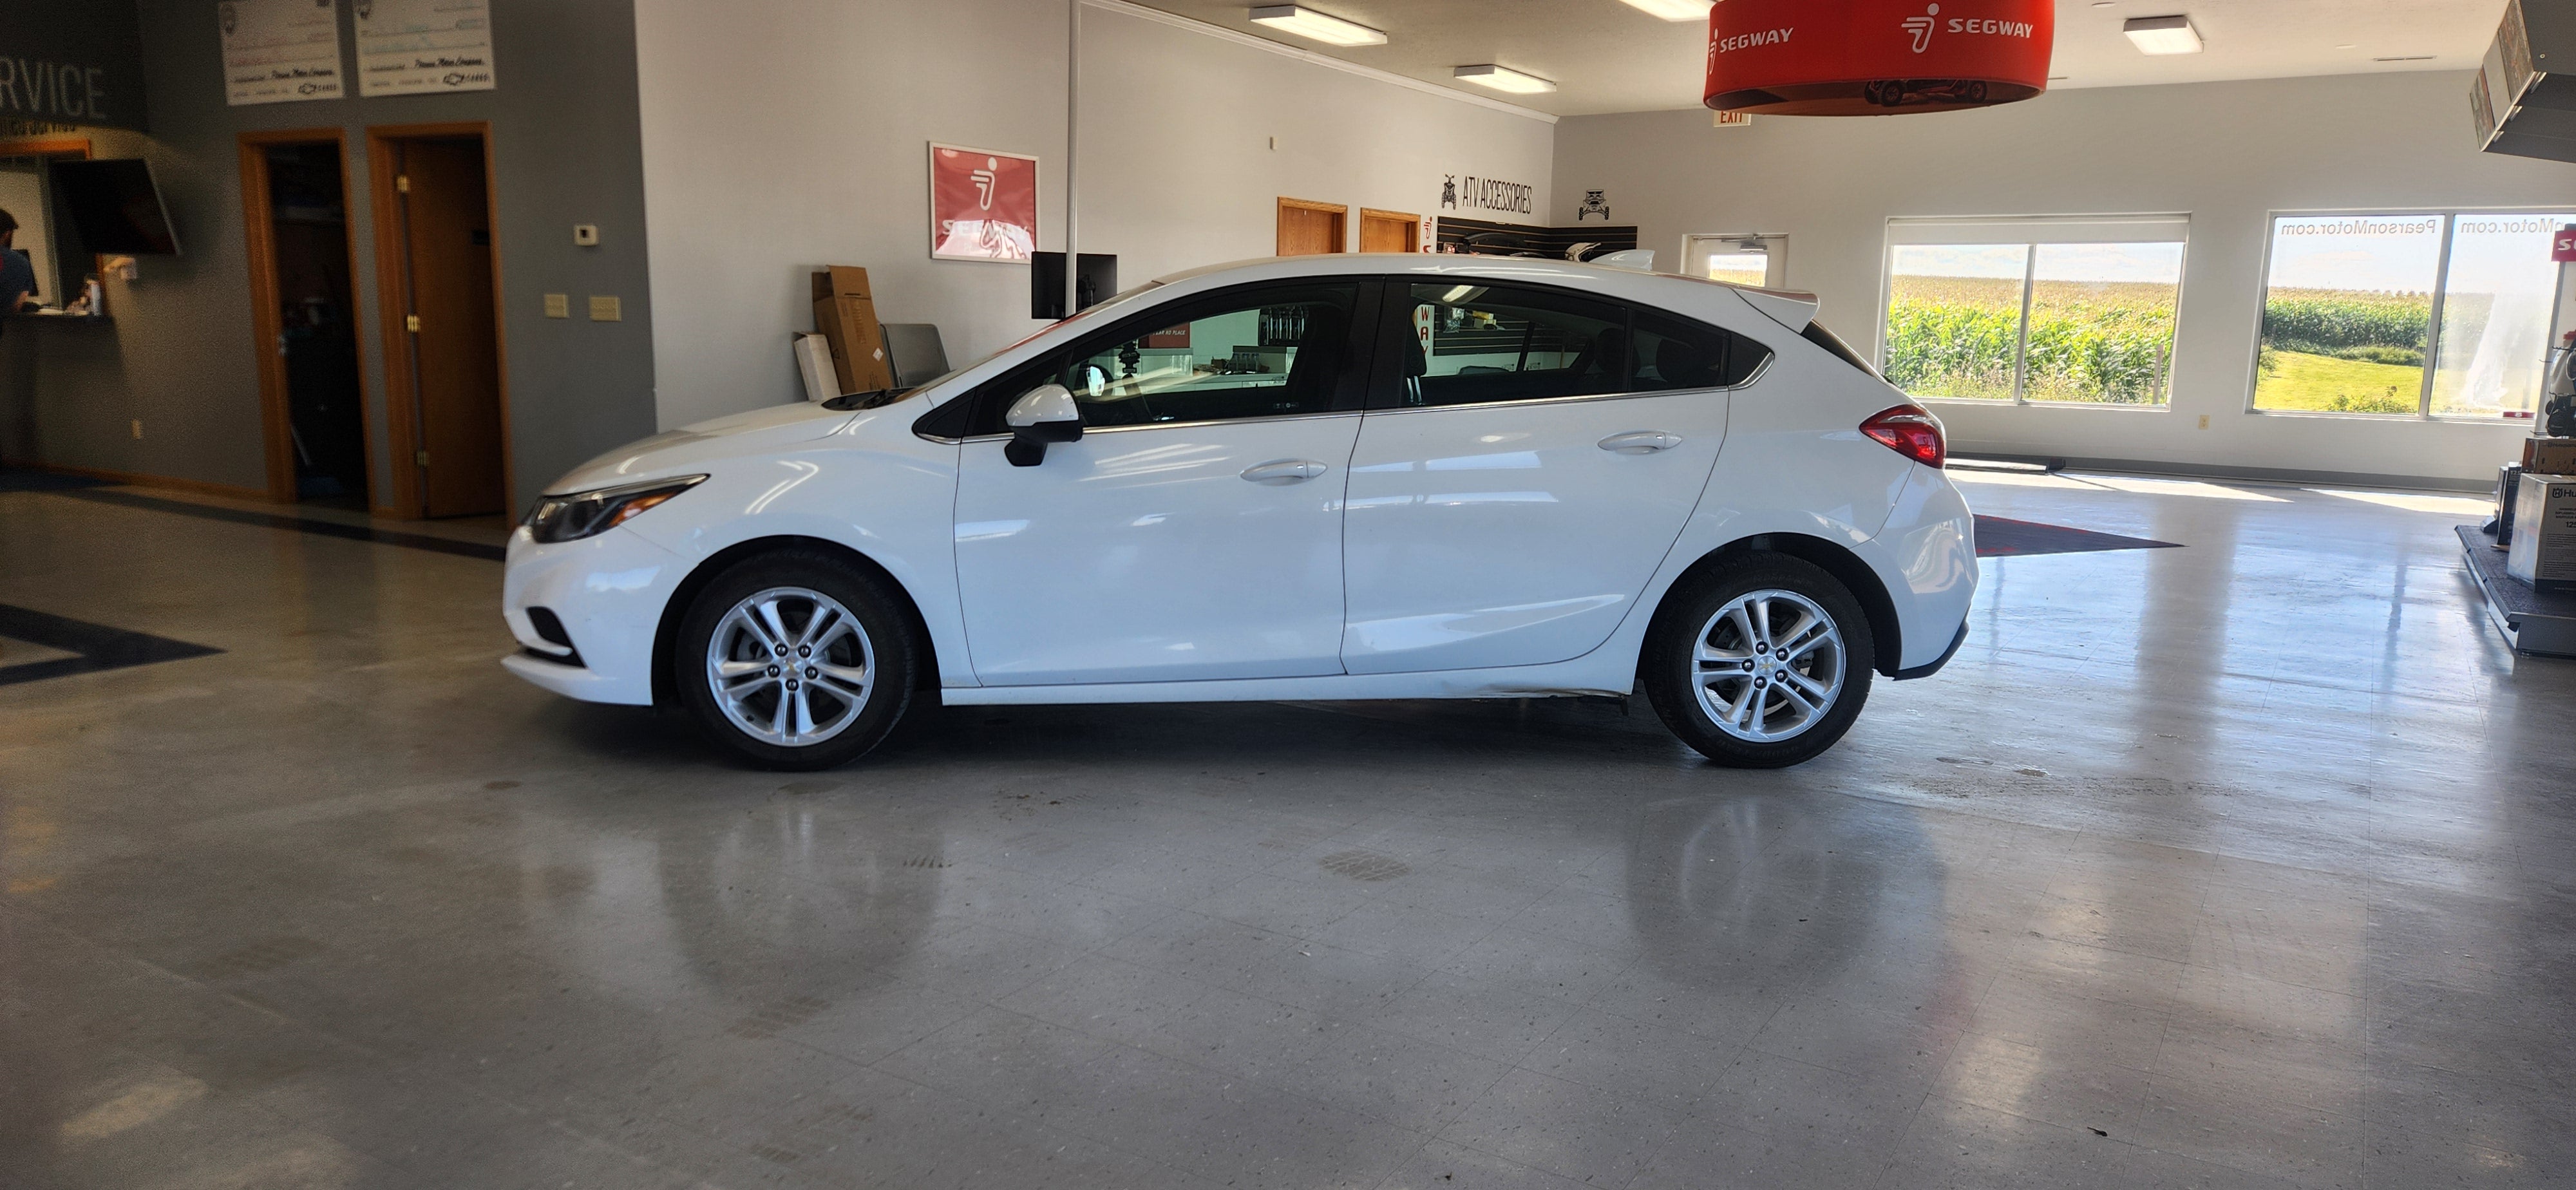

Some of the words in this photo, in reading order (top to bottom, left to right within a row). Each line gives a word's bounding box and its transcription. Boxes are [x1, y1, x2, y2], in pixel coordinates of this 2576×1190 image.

[1947, 19, 2033, 38] SEGWAY
[1719, 27, 1794, 53] SEGWAY
[1720, 111, 1743, 124] EXIT
[1463, 176, 1479, 207] ATV
[1480, 178, 1532, 214] ACCESSORIES
